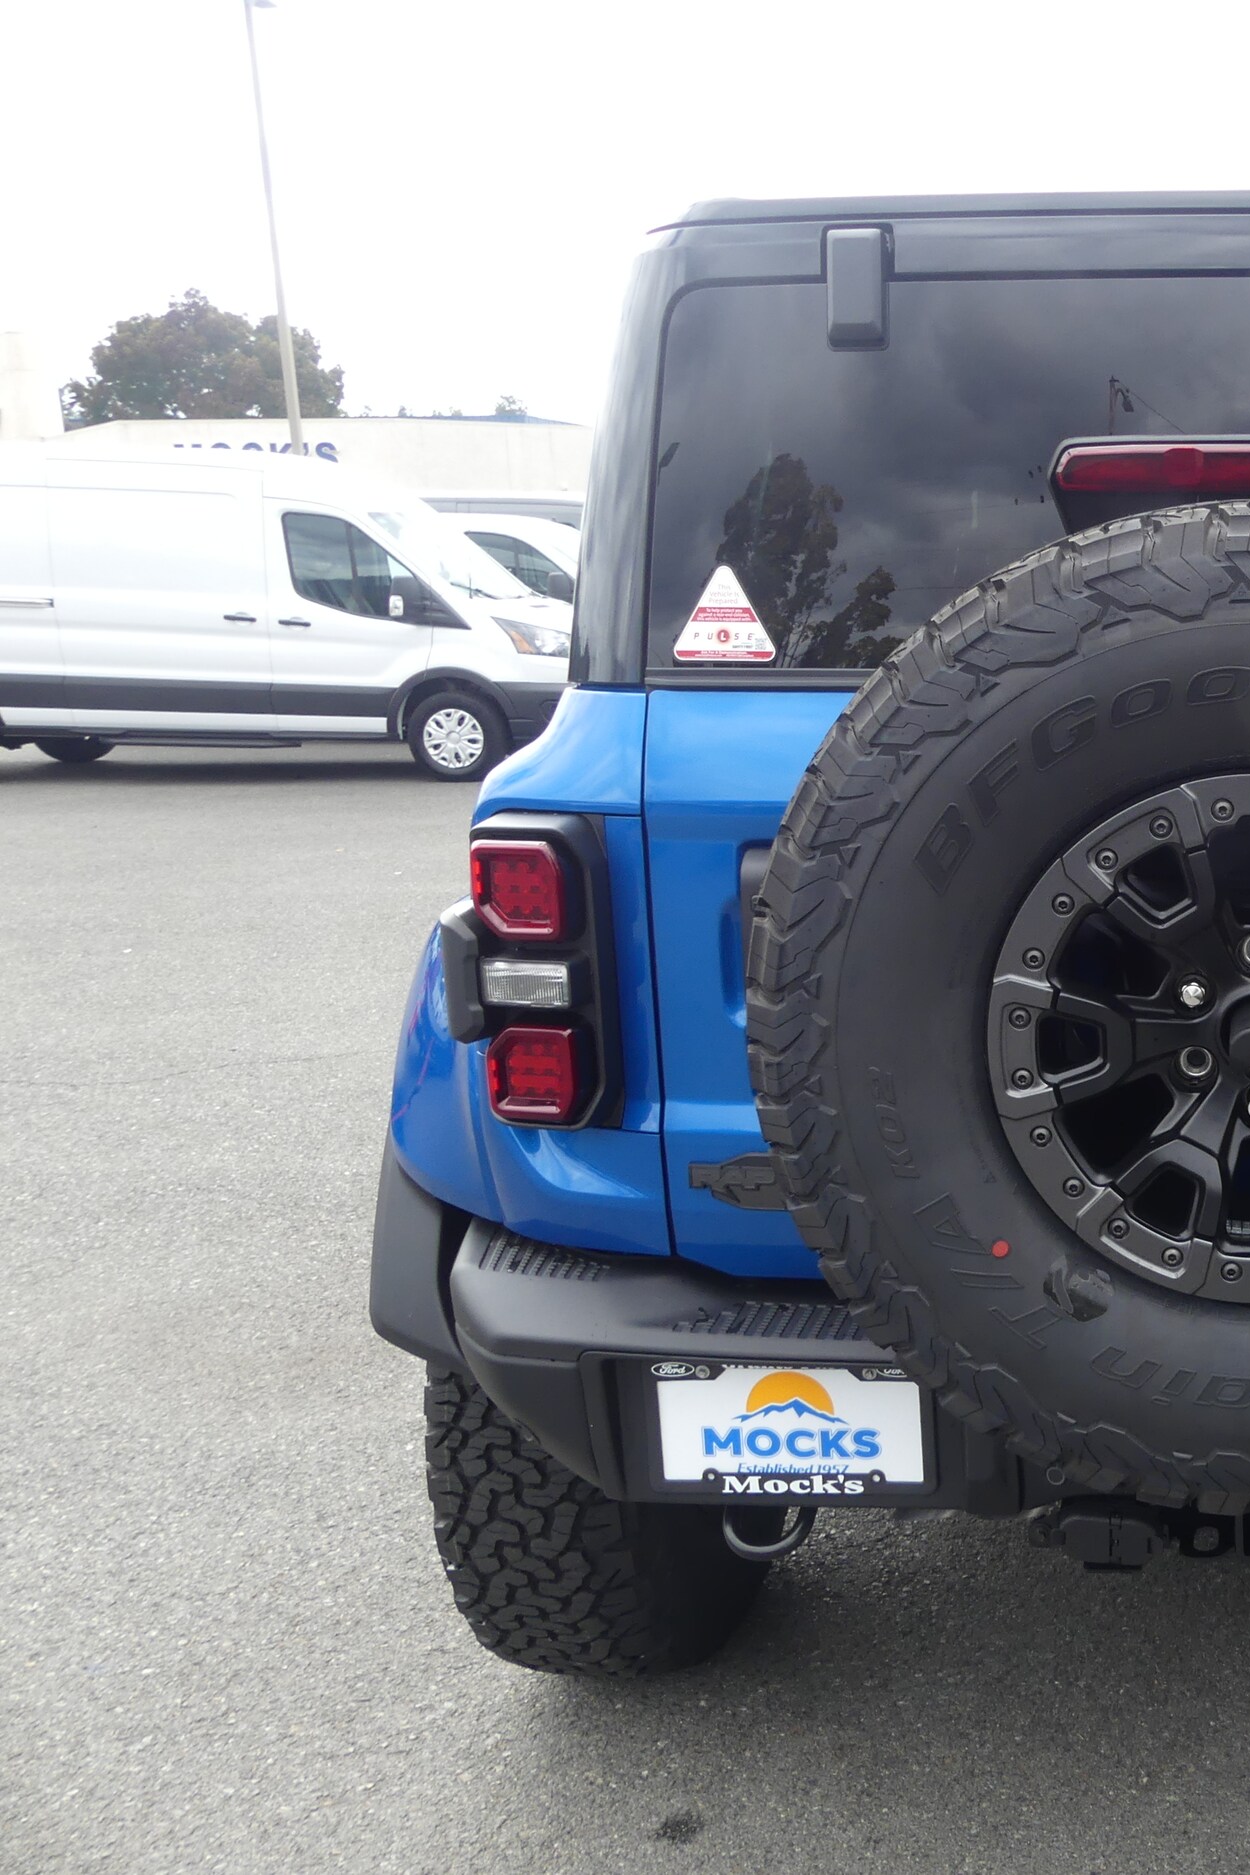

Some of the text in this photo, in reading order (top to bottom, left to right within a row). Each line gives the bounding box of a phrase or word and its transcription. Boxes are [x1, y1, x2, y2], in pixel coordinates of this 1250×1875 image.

[693, 632, 753, 642] PULSE
[659, 1363, 686, 1374] Ford
[701, 1426, 881, 1460] MOCKS
[737, 1462, 849, 1474] Established 1957
[722, 1475, 864, 1495] Mock's
